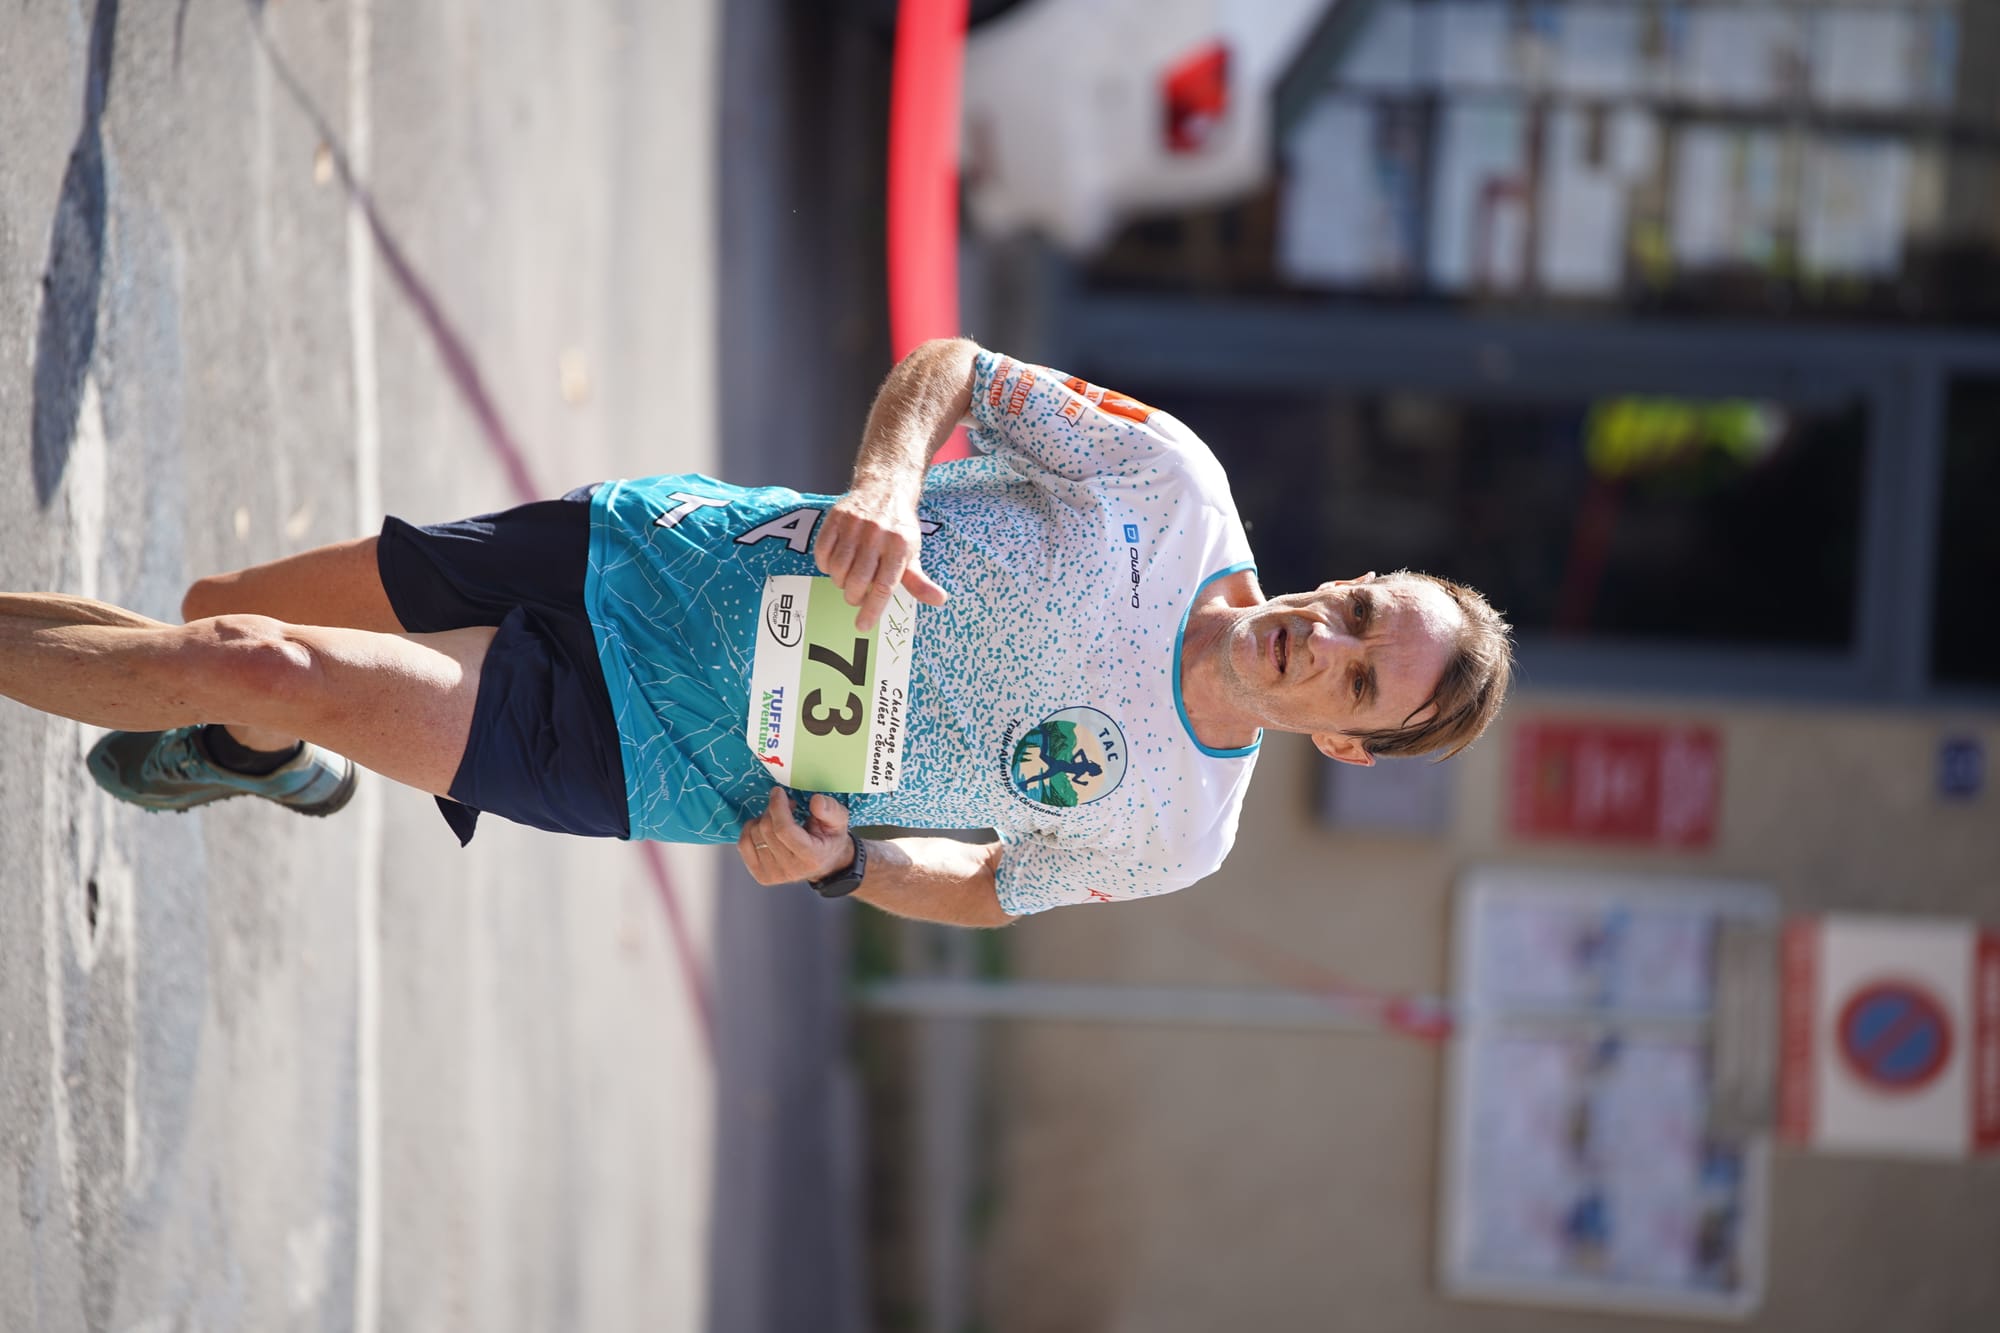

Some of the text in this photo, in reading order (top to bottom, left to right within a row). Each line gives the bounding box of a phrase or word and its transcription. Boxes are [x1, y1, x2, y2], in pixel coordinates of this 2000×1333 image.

[772, 603, 780, 625] GROUP
[777, 594, 793, 639] BFP
[767, 686, 784, 749] TUFF'S
[801, 637, 869, 737] 73
[758, 691, 774, 754] Aventure
[871, 680, 889, 786] vallées cévenoles
[884, 688, 903, 781] Challenge des
[1099, 727, 1119, 763] TAC
